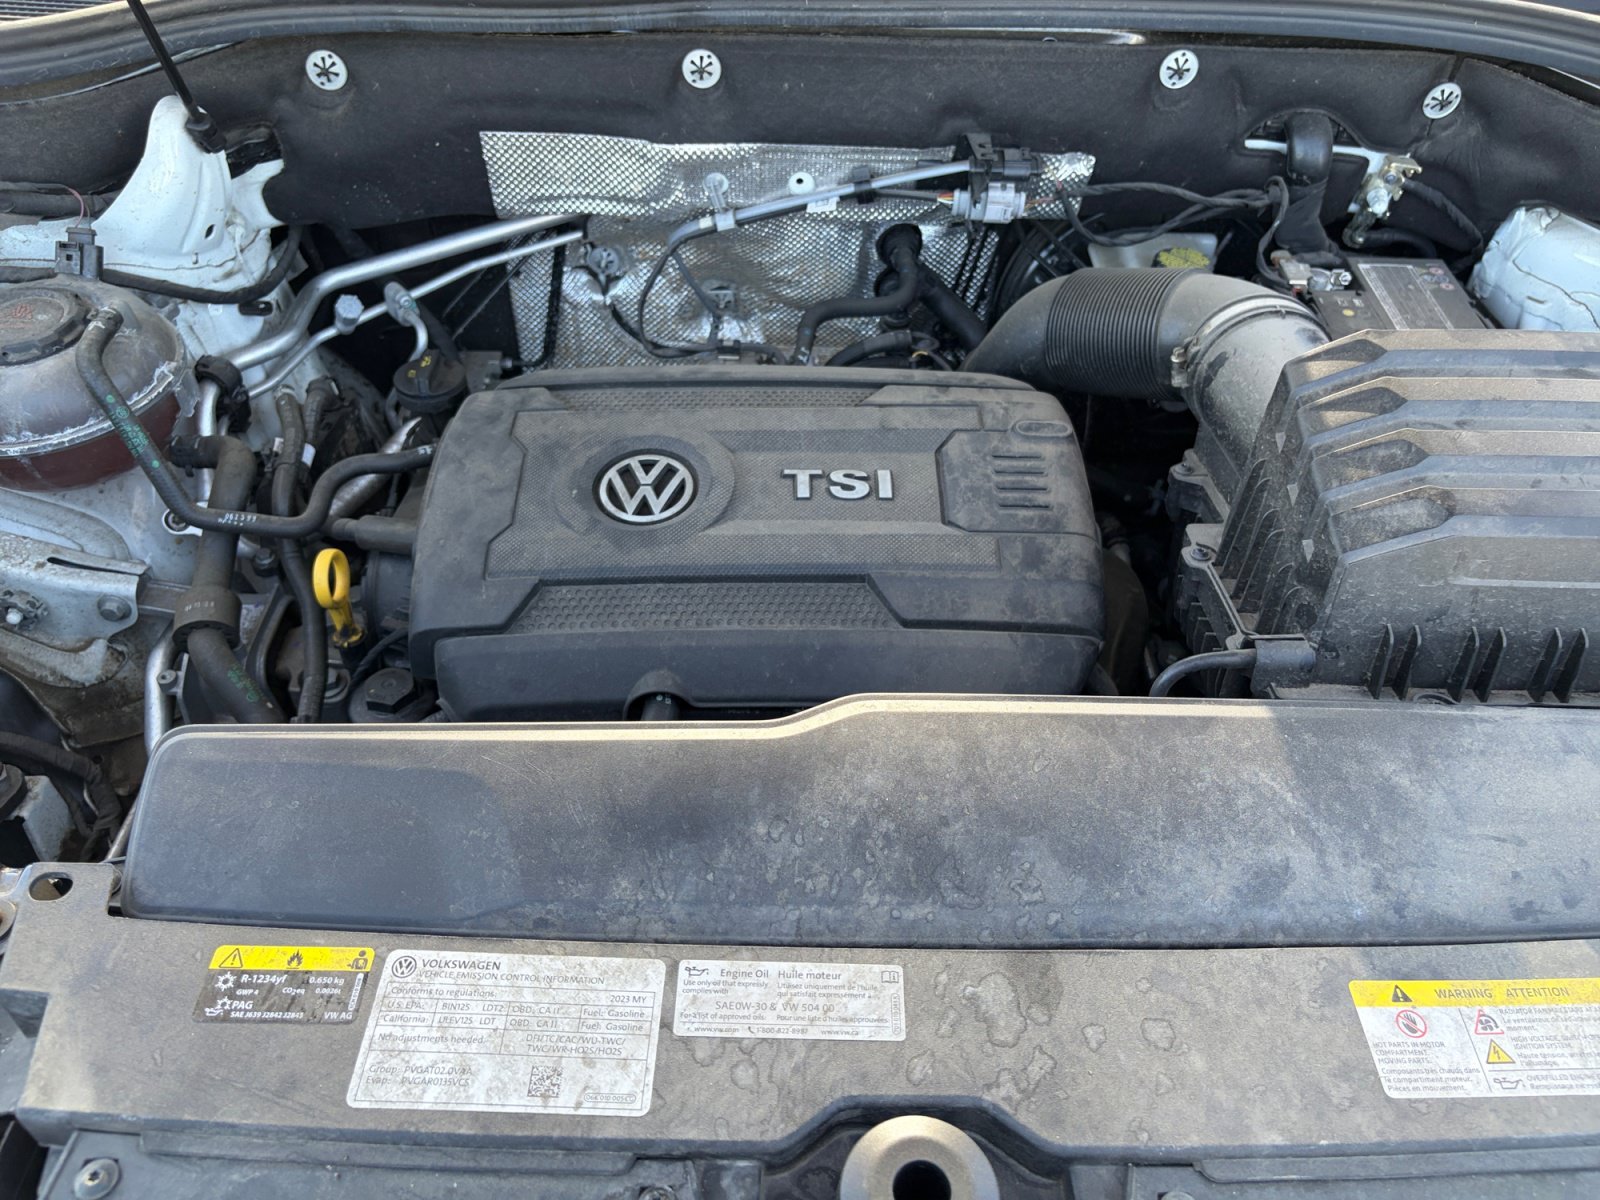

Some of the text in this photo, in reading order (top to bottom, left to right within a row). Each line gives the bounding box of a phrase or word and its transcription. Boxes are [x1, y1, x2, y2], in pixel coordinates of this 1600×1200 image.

[782, 468, 894, 500] TSI
[421, 958, 502, 971] VOLKSWAGEN
[420, 970, 605, 985] VEHICLE EMISSION CONTROL INFORMATION
[720, 968, 769, 980] Engine Oil
[778, 970, 842, 981] Huile moteur
[240, 974, 288, 984] R-1234yf
[308, 976, 345, 986] 0.650 kg
[697, 980, 711, 988] only
[804, 984, 847, 992] uniquement
[391, 985, 498, 998] Conforms to regulations:
[1434, 987, 1570, 999] WARNING ATTENTION
[610, 994, 647, 1005] 2023 MY
[231, 1000, 254, 1010] PAG
[769, 1002, 777, 1011] &
[782, 1003, 799, 1012] VW
[801, 1003, 820, 1012] 504
[822, 1003, 836, 1013] 00
[230, 1011, 244, 1019] SAE
[538, 1006, 552, 1015] CA
[607, 1009, 646, 1018] Gasoline
[324, 1012, 353, 1020] VW AG
[710, 1012, 718, 1020] of
[719, 1013, 752, 1021] approved
[479, 1017, 497, 1026] LDT
[536, 1019, 549, 1028] CA
[605, 1023, 644, 1032] Gasoline
[377, 1032, 392, 1042] No
[392, 1034, 448, 1044] adjustments
[1388, 1041, 1410, 1049] PARTS
[1381, 1067, 1425, 1076] Composants
[1393, 1076, 1444, 1084] compartiment
